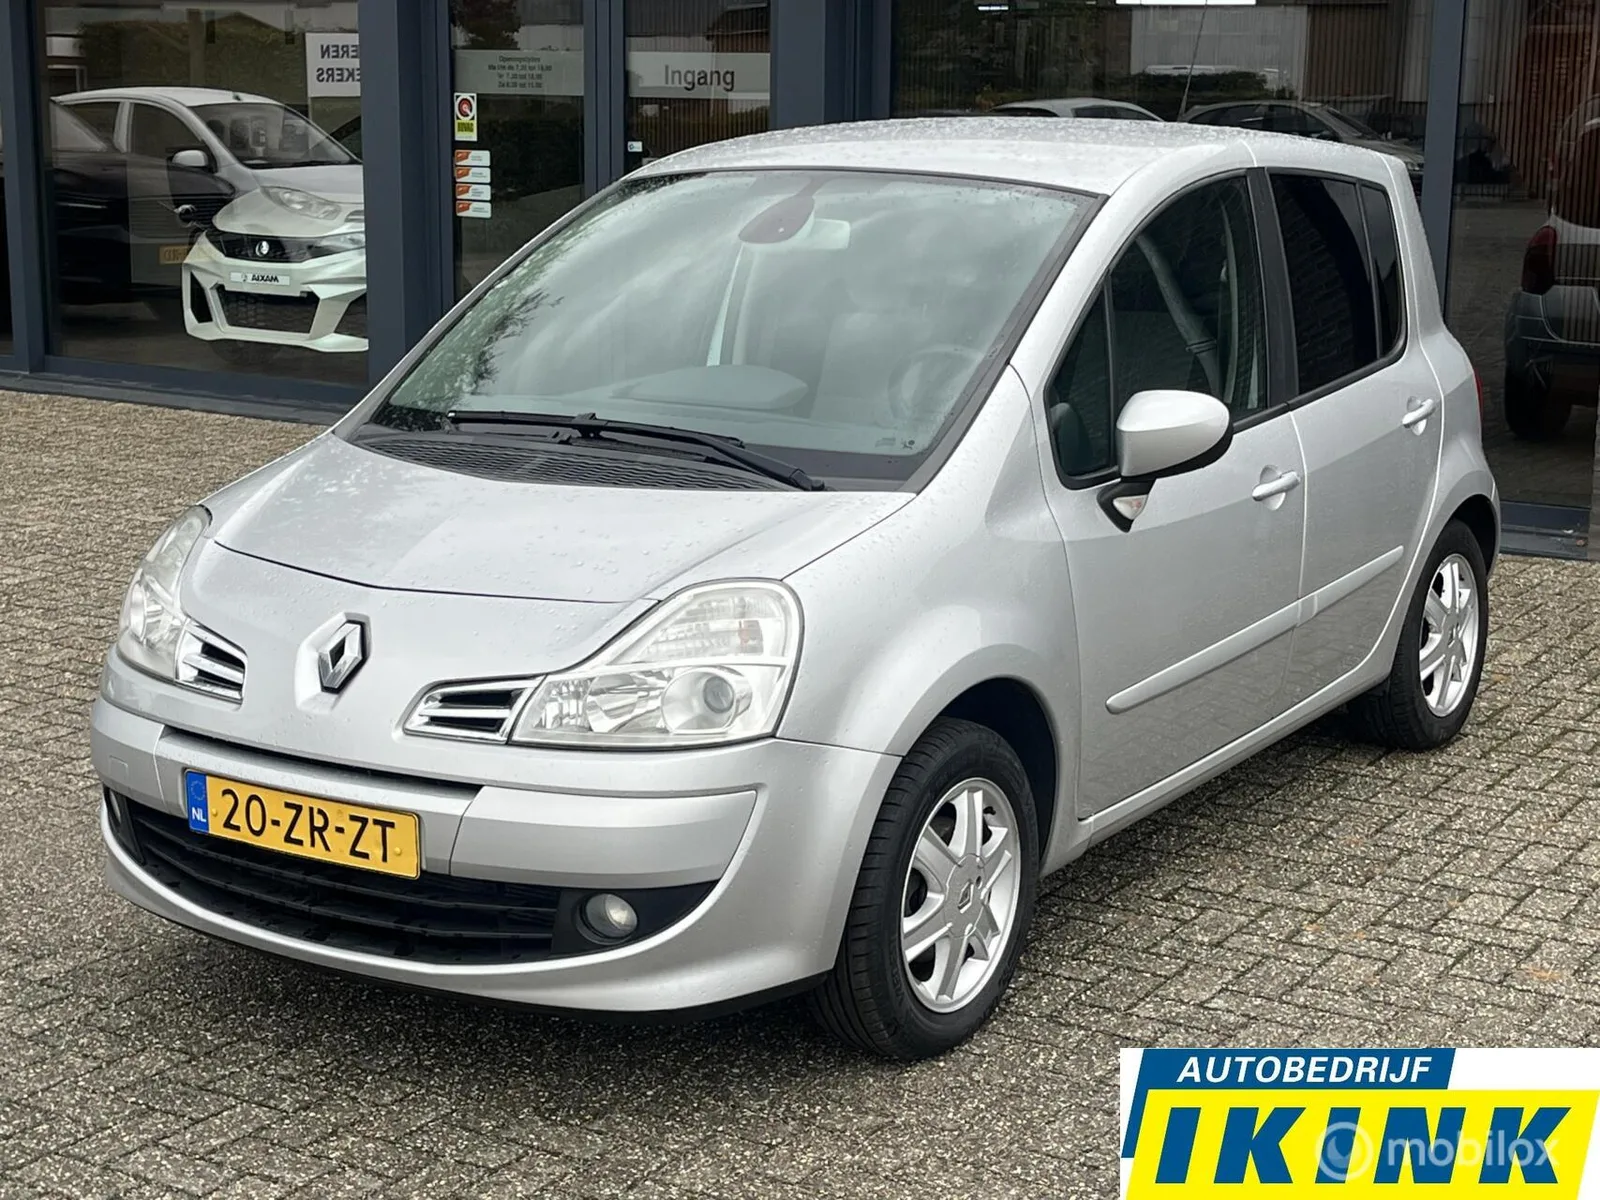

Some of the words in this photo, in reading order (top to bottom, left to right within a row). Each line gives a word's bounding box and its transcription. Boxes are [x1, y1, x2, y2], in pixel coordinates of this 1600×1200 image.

[664, 64, 735, 92] Ingang
[191, 806, 207, 824] NL
[221, 788, 396, 864] 20-ZR-ZT
